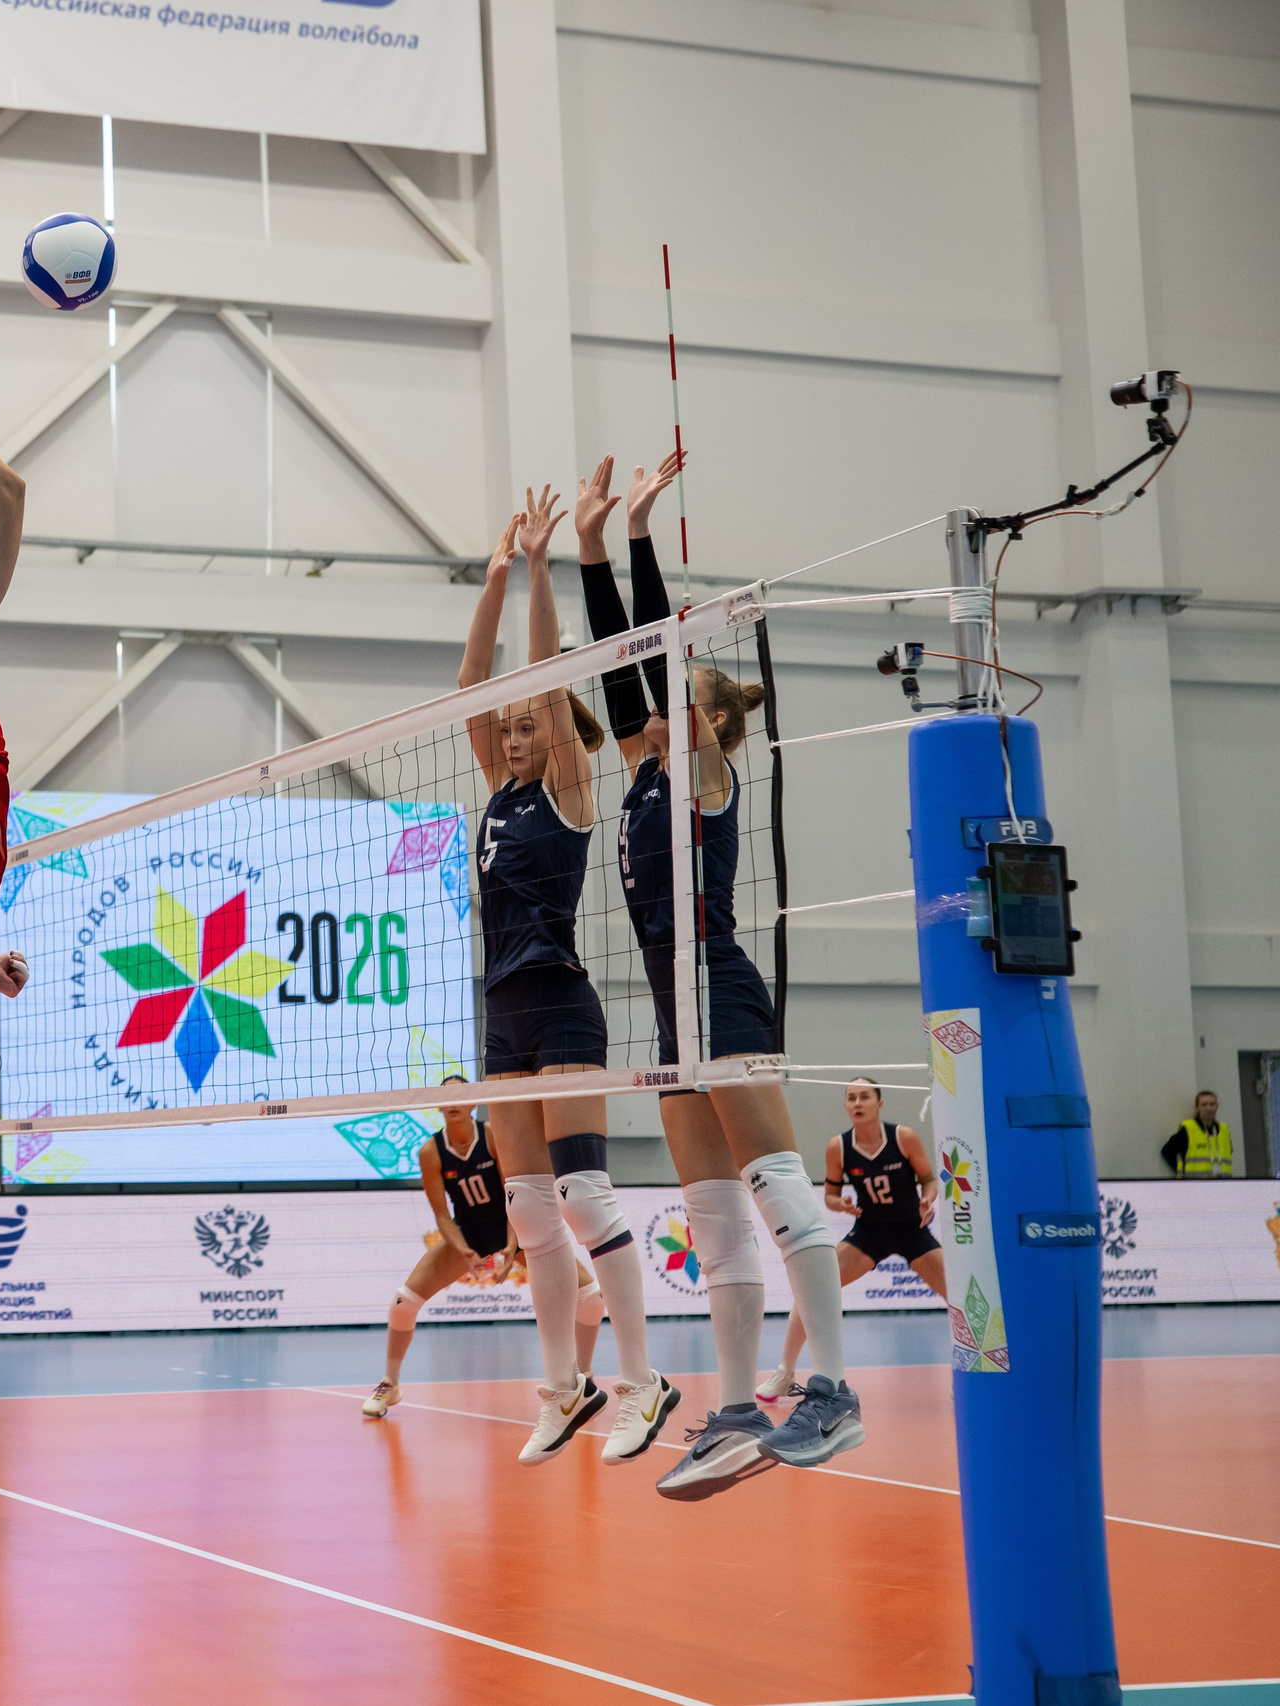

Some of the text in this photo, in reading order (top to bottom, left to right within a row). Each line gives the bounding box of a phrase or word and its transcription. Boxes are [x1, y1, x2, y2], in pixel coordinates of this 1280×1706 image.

[157, 5, 291, 35] федерация
[298, 21, 420, 50] волейбола
[479, 817, 506, 873] 5
[149, 851, 262, 885] РОССИИ
[71, 876, 130, 1010] НАРОДОВ
[277, 911, 407, 1006] 2026
[458, 1174, 491, 1207] 10
[862, 1174, 894, 1204] 12
[953, 1201, 974, 1245] 2026
[1043, 1223, 1097, 1238] Senoh
[200, 1289, 284, 1303] МИНСПОРТ
[213, 1308, 278, 1322] РОССИИ
